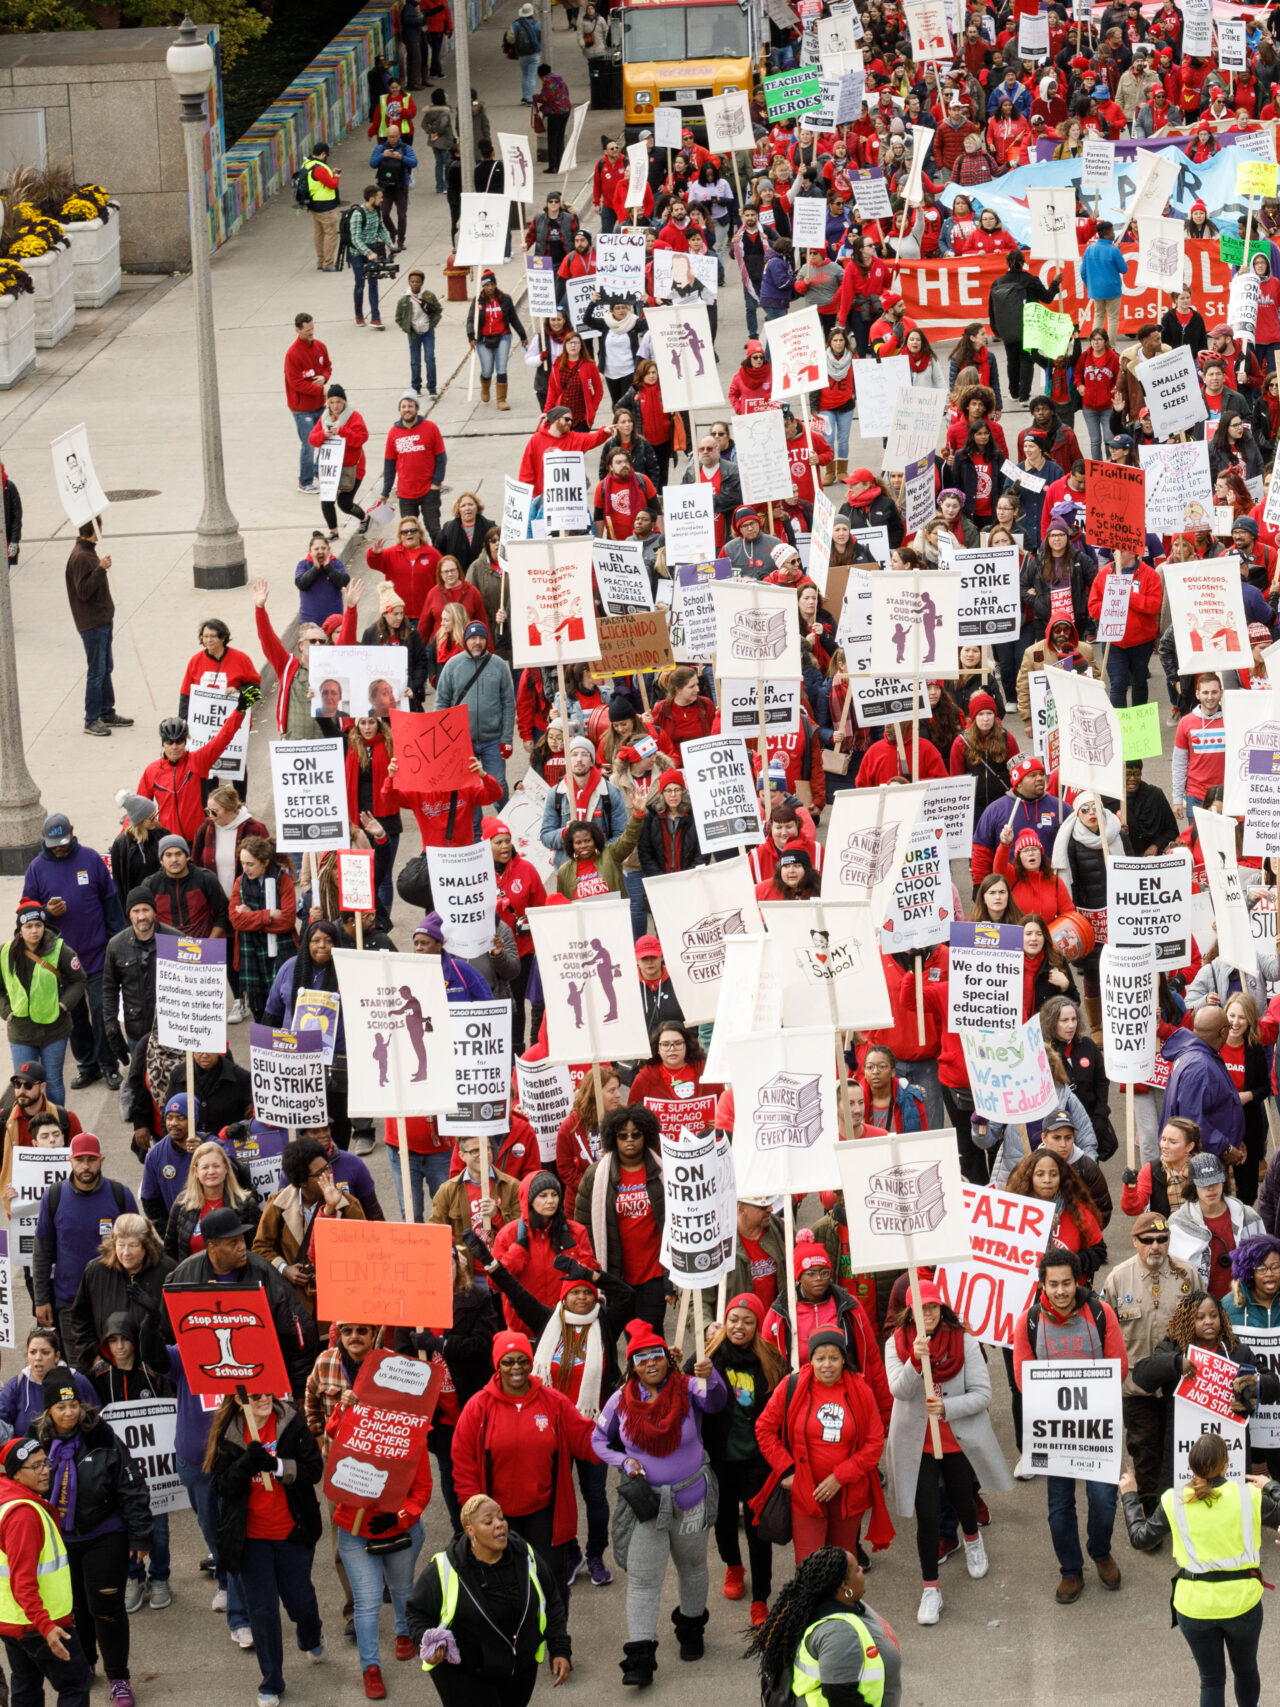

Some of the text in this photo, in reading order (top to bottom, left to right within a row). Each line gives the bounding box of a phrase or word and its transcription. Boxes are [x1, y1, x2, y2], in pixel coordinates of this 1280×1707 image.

[678, 67, 715, 77] CREAM
[764, 70, 817, 91] TEACHERS
[783, 87, 801, 98] are
[768, 95, 822, 118] HEROES
[600, 235, 644, 247] CHICAGO
[1151, 368, 1190, 388] SMALLER
[1160, 382, 1187, 398] CLASS
[1162, 395, 1189, 411] SIZES!
[553, 468, 570, 482] ON
[546, 488, 583, 502] STRIKE
[609, 553, 623, 562] EN
[599, 560, 641, 575] HUELGA
[973, 562, 996, 575] ON
[604, 578, 643, 589] PRACTICAS
[961, 574, 1011, 588] STRIKE
[607, 586, 642, 595] INJUSTAS
[608, 592, 646, 602] LABORALES
[974, 597, 999, 606] FAIR
[958, 603, 1017, 617] CONTRACT
[402, 713, 464, 774] SIZE
[293, 757, 317, 771] ON
[282, 770, 335, 786] STRIKE
[288, 795, 330, 807] BETTER
[284, 805, 338, 818] SCHOOLS
[439, 872, 489, 888] SMALLER
[1139, 877, 1161, 890] EN
[448, 892, 484, 905] CLASS
[1116, 889, 1182, 905] HUELGA
[450, 910, 486, 923] SIZES!
[1118, 913, 1181, 925] CONTRATO
[1132, 924, 1170, 936] JUSTO
[974, 937, 999, 946] SEIU
[177, 952, 202, 961] SEIU
[951, 948, 1022, 959] #FairContractNow
[158, 959, 225, 973] #FairContractNow
[952, 959, 1020, 975] We do this
[159, 970, 223, 986] SECAs, bus aides,
[965, 974, 1008, 988] for our
[1106, 972, 1152, 988] A NURSE
[158, 983, 224, 1001] custodians, security
[377, 986, 397, 996] STOP
[962, 989, 1009, 1003] special
[1106, 988, 1153, 1004] IN EVERY
[158, 997, 180, 1008] officers
[191, 1000, 210, 1009] strike
[212, 1002, 225, 1010] for:
[360, 997, 403, 1008] STARVING
[953, 1002, 1018, 1016] education
[159, 1009, 223, 1022] Justice for Students.
[371, 1010, 388, 1019] OUR
[1106, 1005, 1152, 1020] SCHOOL
[169, 1022, 214, 1037] School Equity.
[367, 1020, 405, 1030] SCHOOLS
[955, 1016, 1016, 1030] students!
[1111, 1020, 1149, 1036] EVERY
[178, 1035, 202, 1047] Dignity.
[1115, 1036, 1146, 1050] DAY!
[252, 1059, 322, 1075] SEIU Local 73
[254, 1075, 323, 1092] On STRIKE
[255, 1091, 325, 1107] for Chicago's
[257, 1108, 325, 1124] Families!
[874, 1177, 916, 1196] A NURSE
[875, 1213, 926, 1231] EVERY DAY
[329, 1226, 431, 1246] Substitute Teachers
[330, 1262, 434, 1283] CONTRACT
[363, 1299, 408, 1321] DAY 1
[188, 1314, 256, 1326] Stop Starving
[215, 1366, 254, 1377] Schools
[1032, 1369, 1110, 1379] CHICAGO PUBLIC SCHOOLS
[1057, 1386, 1088, 1411] ON
[353, 1405, 427, 1428] WE SUPPORT
[359, 1418, 410, 1437] CHICAGO
[1032, 1419, 1114, 1439] STRIKE
[353, 1427, 411, 1448] TEACHERS
[347, 1437, 409, 1459] AND STAFF
[1033, 1442, 1114, 1454] FOR BETTER SCHOOLS
